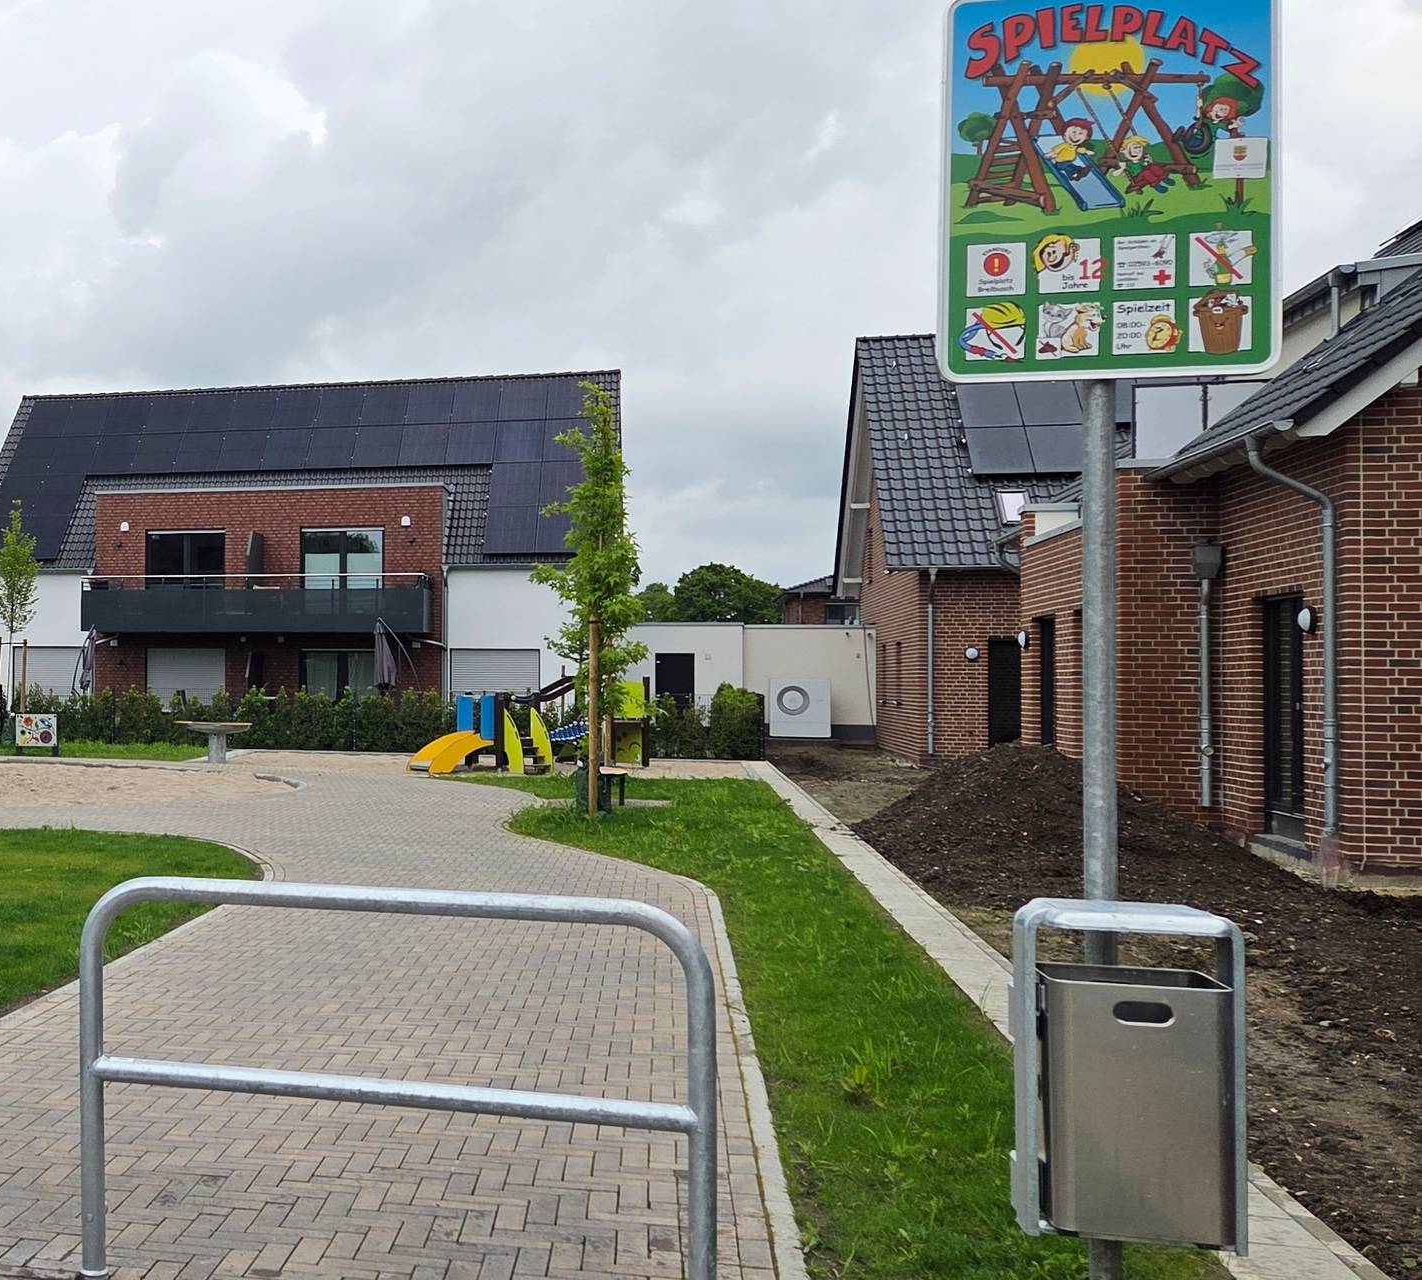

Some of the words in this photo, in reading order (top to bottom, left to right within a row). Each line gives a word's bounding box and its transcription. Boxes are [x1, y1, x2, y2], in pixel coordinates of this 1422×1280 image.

[964, 3, 1262, 89] SPIELPLATZ
[1062, 273, 1075, 281] bis
[1079, 257, 1106, 280] 12
[1062, 282, 1089, 290] Jahre
[1117, 302, 1170, 315] Spielzeit
